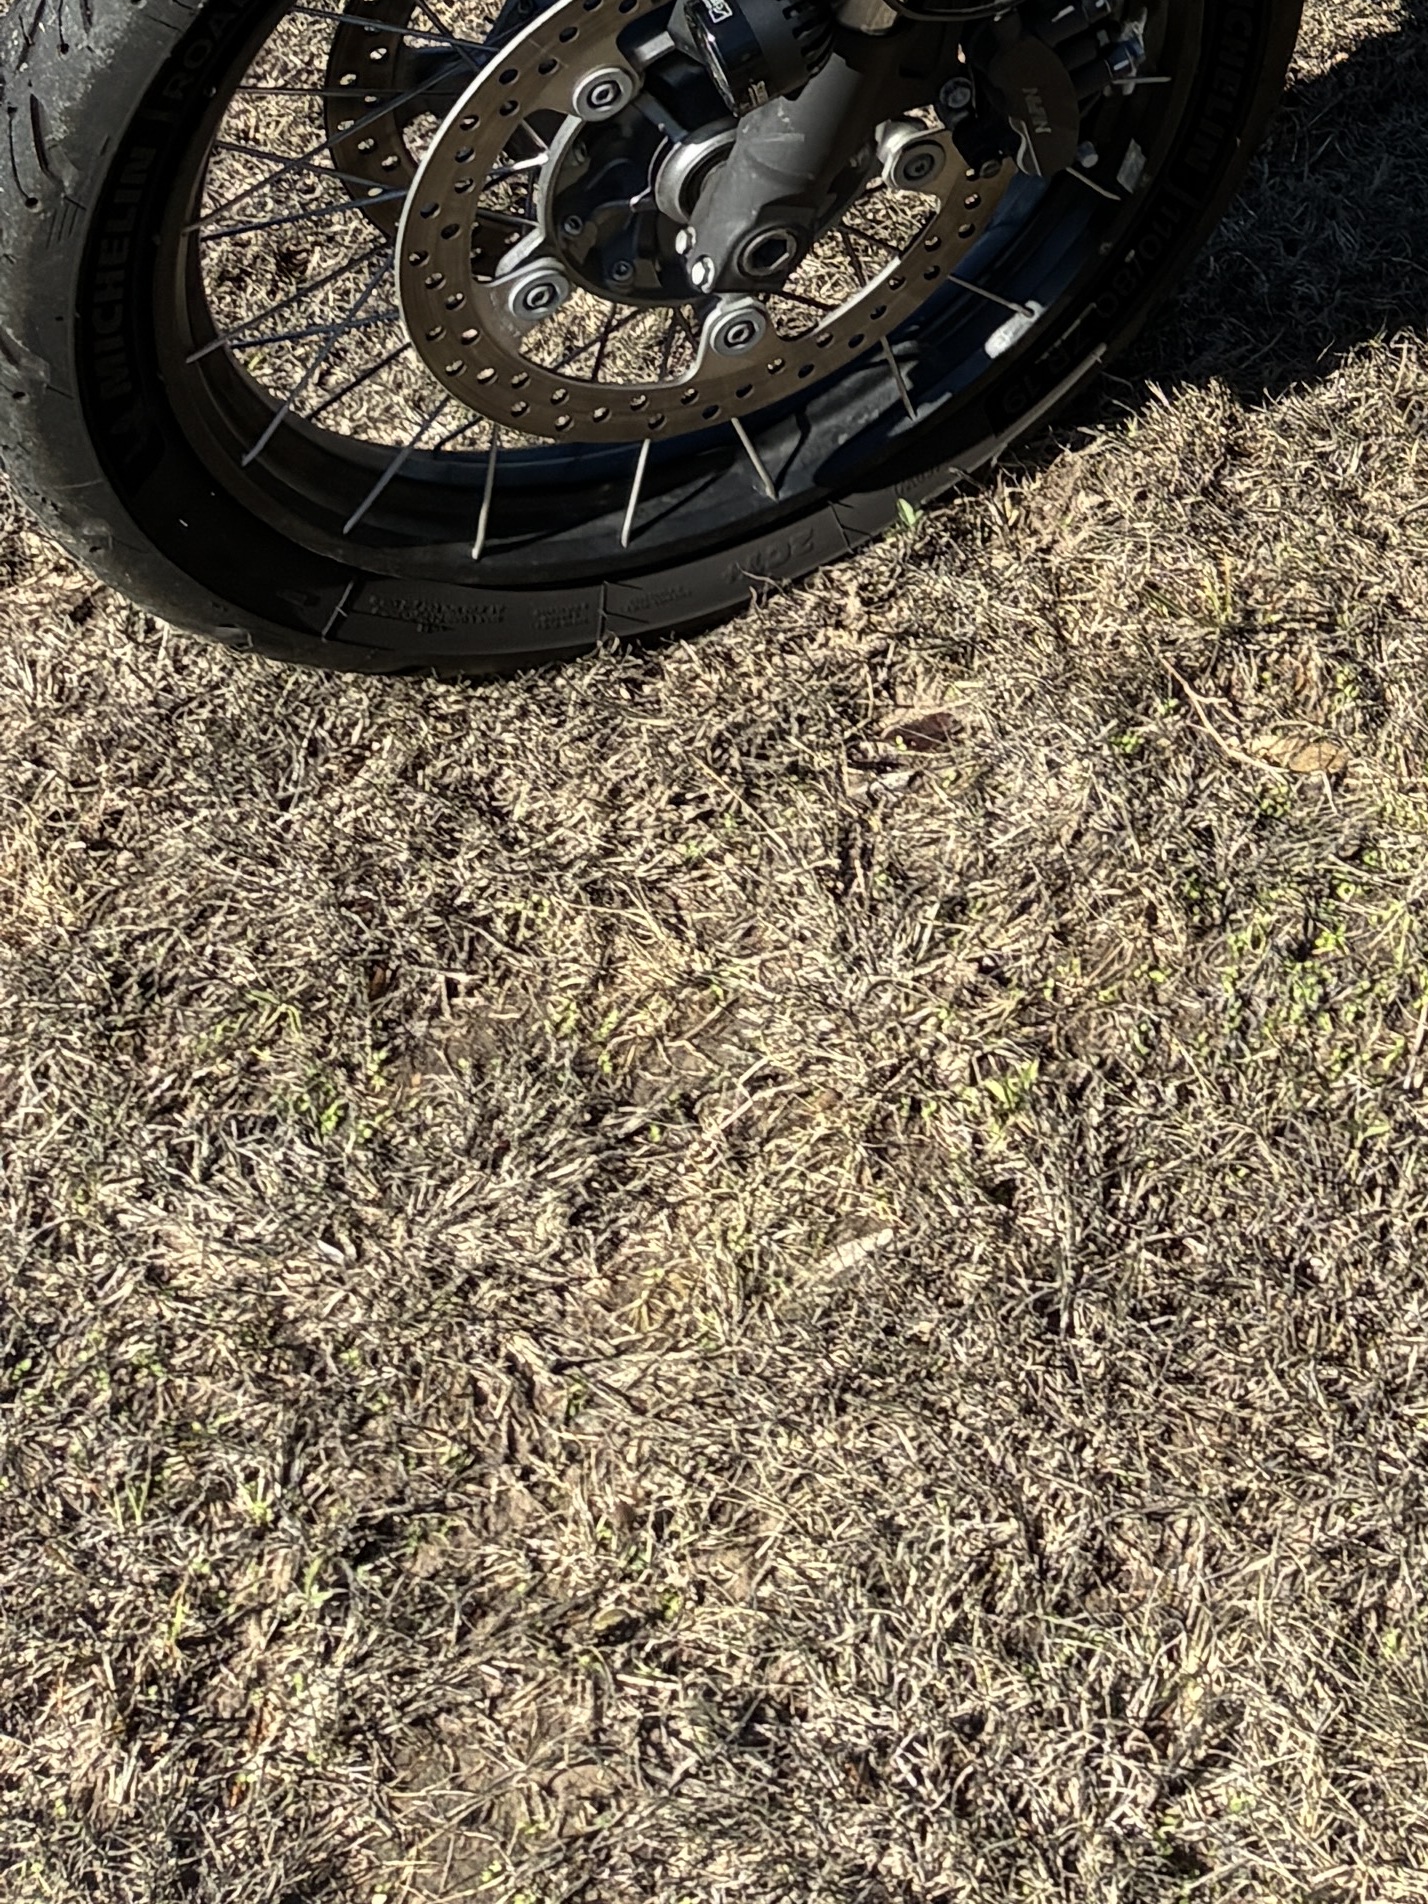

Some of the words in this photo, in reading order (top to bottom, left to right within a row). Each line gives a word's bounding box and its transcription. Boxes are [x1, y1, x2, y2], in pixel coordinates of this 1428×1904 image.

[91, 145, 158, 402] MICHELIN
[1094, 205, 1184, 320] 110/80
[1001, 376, 1041, 415] 19
